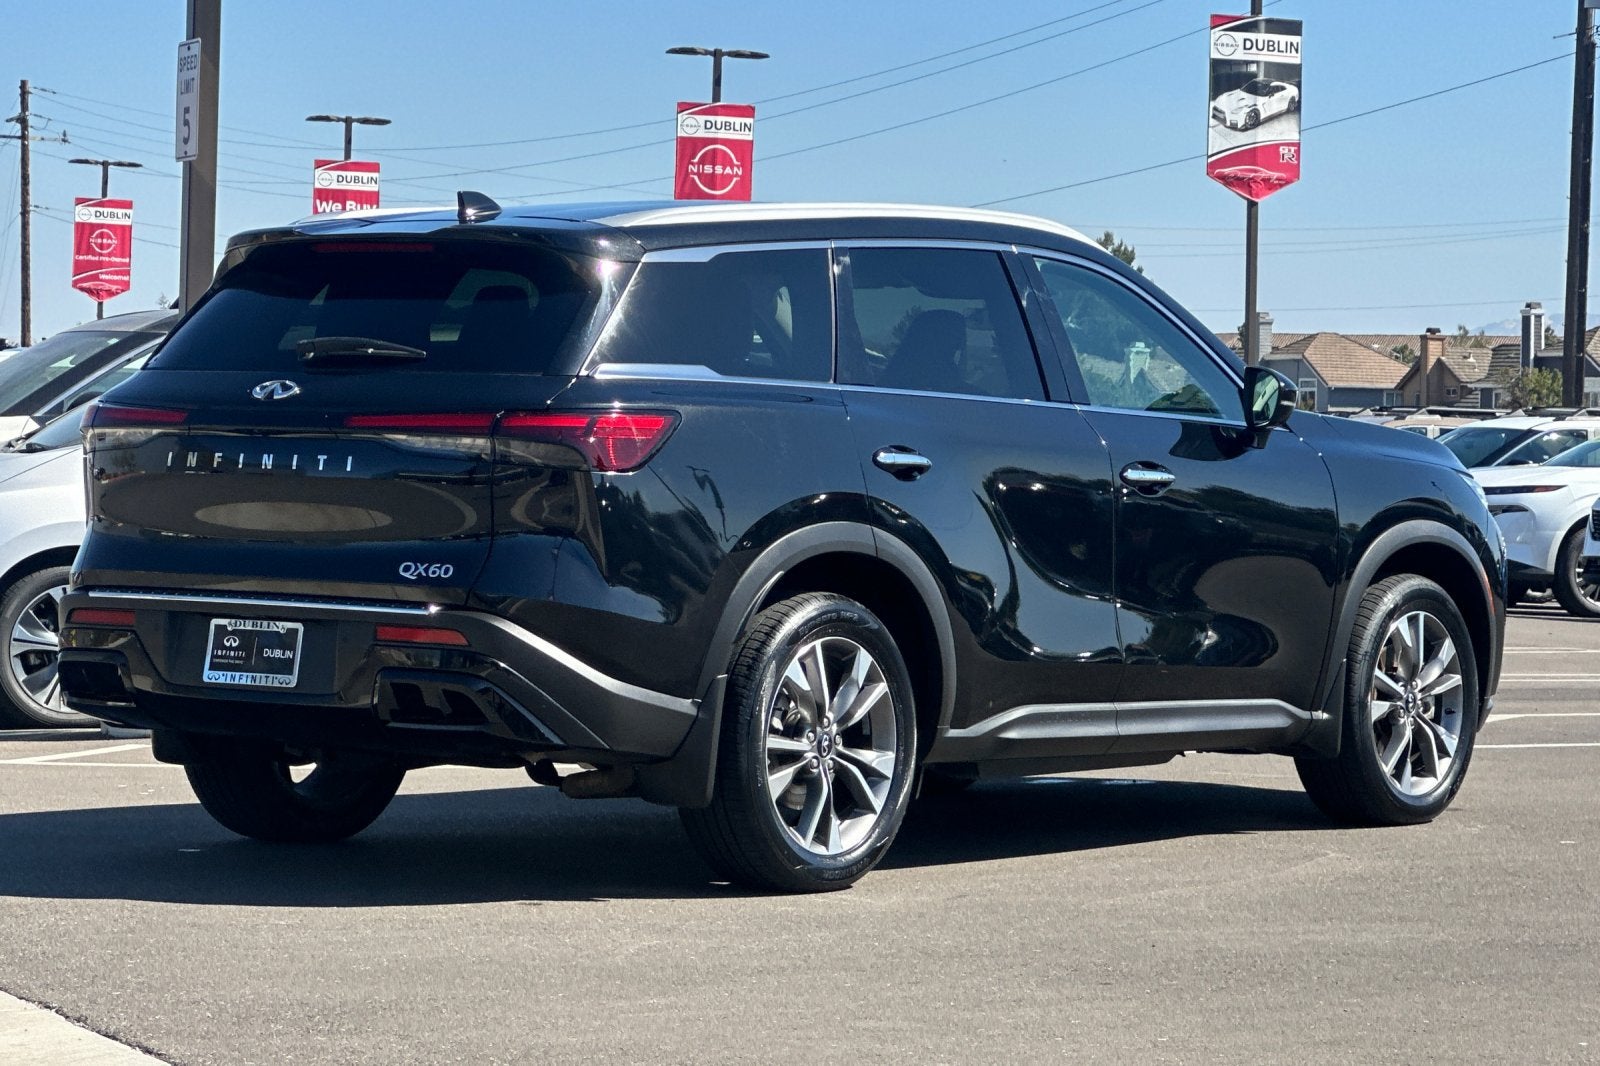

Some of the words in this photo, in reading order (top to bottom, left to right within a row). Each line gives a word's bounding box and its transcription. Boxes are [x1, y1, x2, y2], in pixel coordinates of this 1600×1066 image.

[1243, 37, 1300, 55] DUBLIN
[179, 53, 198, 73] SPEED
[180, 77, 195, 95] LIMIT
[182, 106, 191, 145] 5
[704, 119, 752, 132] DUBLIN
[688, 164, 743, 175] NISSAN
[336, 174, 378, 185] DUBLIN
[316, 198, 343, 213] We
[94, 210, 131, 219] DUBLIN
[166, 451, 353, 472] INFINITI
[398, 561, 454, 579] QX60
[234, 620, 280, 630] DUBLIN
[214, 649, 246, 657] INFINITI
[263, 648, 293, 659] DUBLIN
[224, 673, 275, 683] INFINITI
